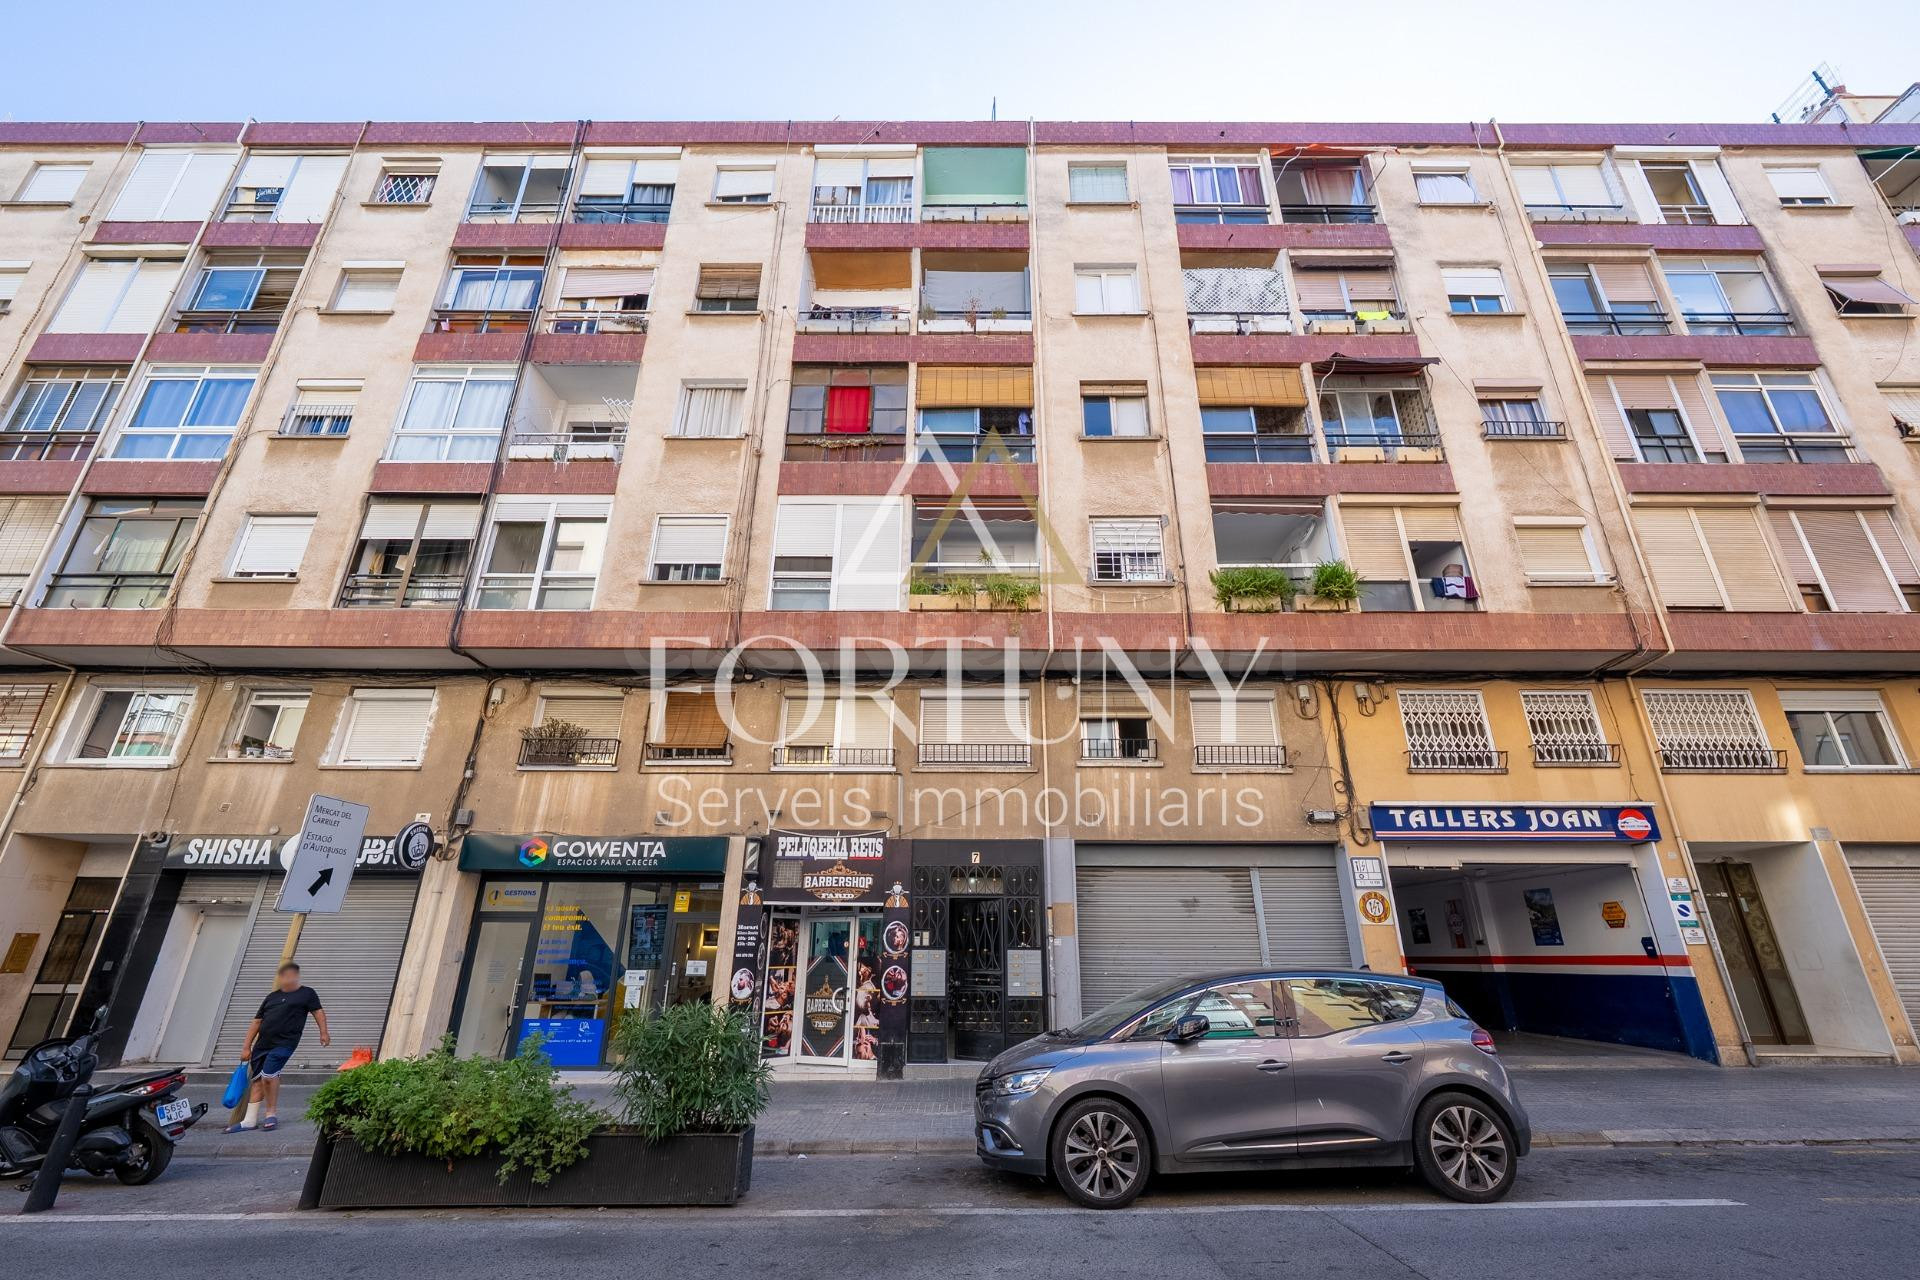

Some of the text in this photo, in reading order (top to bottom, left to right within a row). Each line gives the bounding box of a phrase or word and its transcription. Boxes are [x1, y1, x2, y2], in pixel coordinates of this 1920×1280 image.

[314, 805, 341, 817] MERCAT
[1389, 808, 1603, 832] TALLERS JOAN
[184, 839, 272, 865] SHISHA
[553, 841, 667, 858] COWENTA
[850, 838, 884, 858] REUS
[557, 858, 598, 866] ESPACIOS
[626, 858, 658, 866] CRECER
[972, 852, 980, 863] 7
[803, 876, 874, 888] BARBERSHOP
[164, 1100, 188, 1114] 5650
